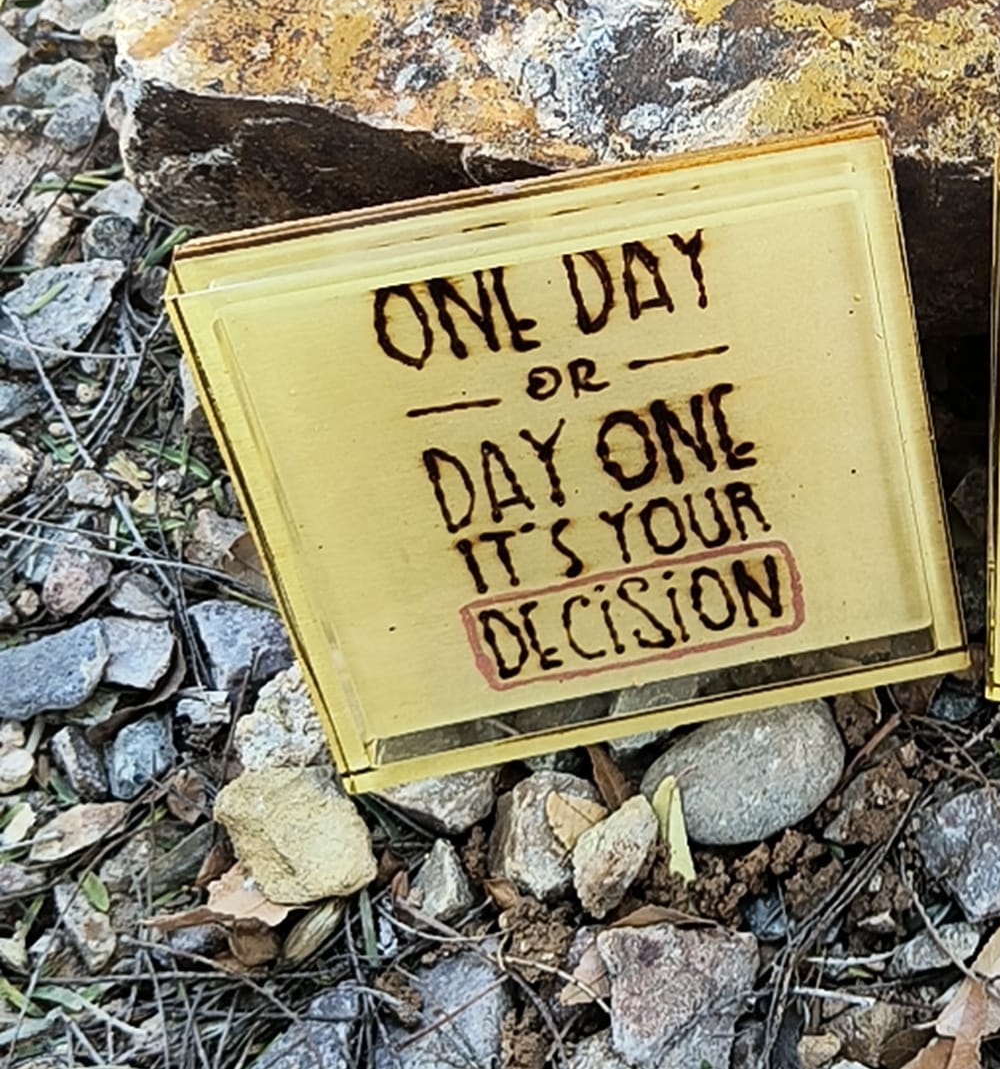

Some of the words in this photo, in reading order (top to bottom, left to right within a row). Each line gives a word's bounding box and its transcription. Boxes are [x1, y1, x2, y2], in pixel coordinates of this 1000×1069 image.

[371, 267, 542, 371] ONE
[562, 227, 710, 336] DAY
[525, 358, 610, 400] OR
[420, 418, 568, 535] DAY
[595, 381, 758, 491] ONE
[454, 517, 585, 594] IT'S
[599, 480, 772, 565] YOUR
